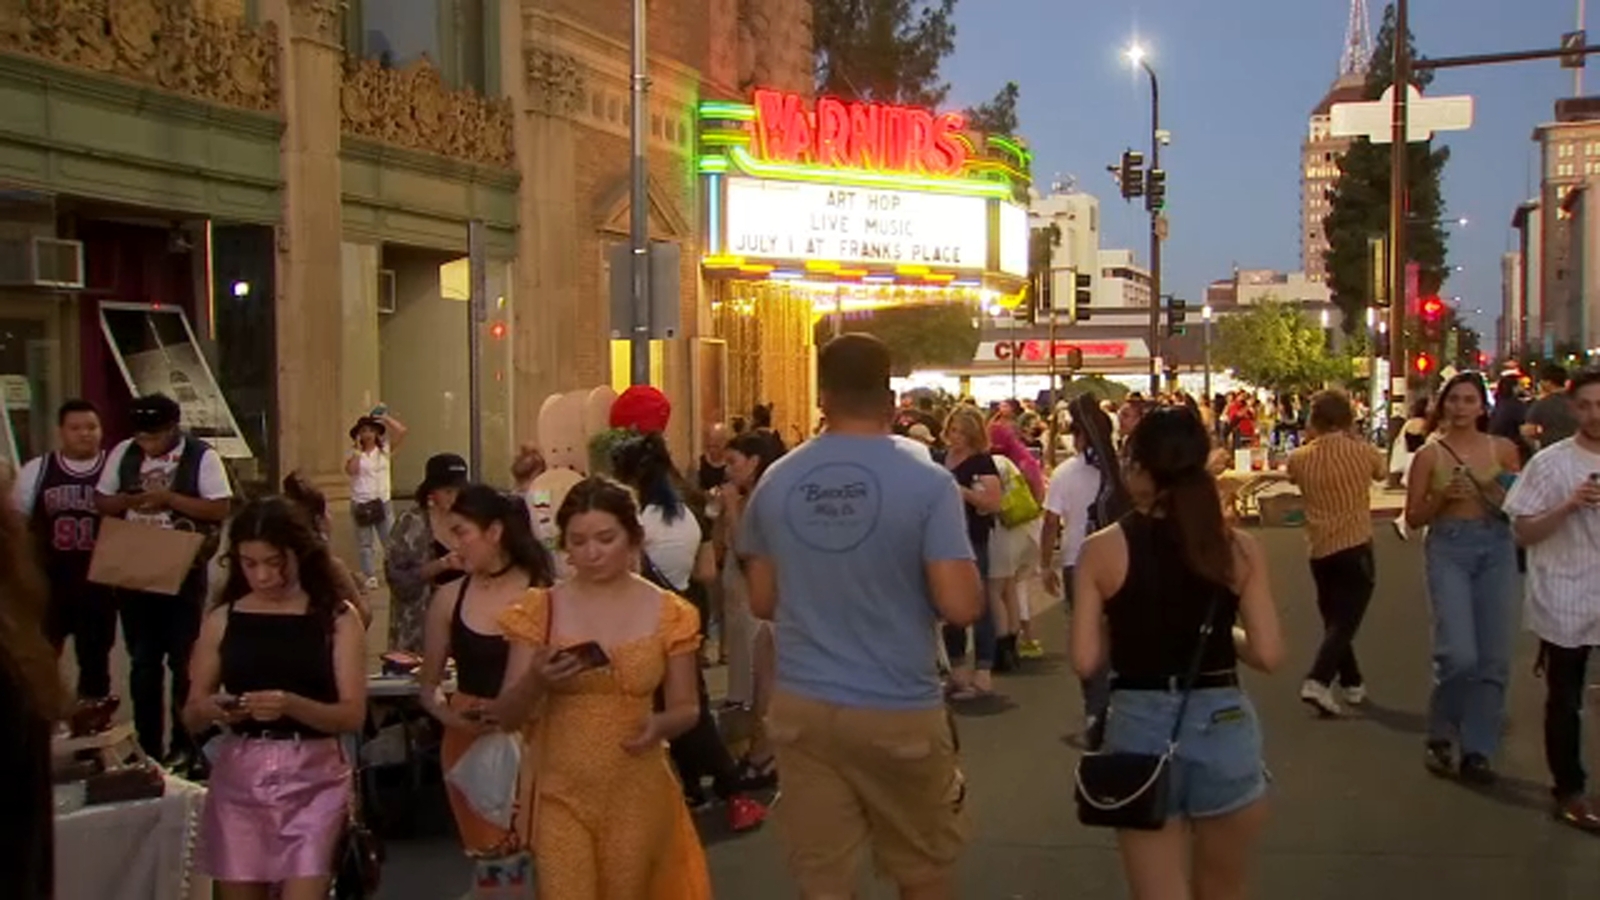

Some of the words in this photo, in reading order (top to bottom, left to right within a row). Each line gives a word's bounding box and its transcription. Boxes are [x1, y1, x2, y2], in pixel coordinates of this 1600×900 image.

[826, 190, 856, 207] ART
[867, 194, 901, 211] HOP
[810, 213, 849, 232] LIVE
[864, 219, 914, 237] MUSIC
[736, 234, 777, 254] JULY
[805, 237, 824, 255] AT
[840, 240, 902, 260] FRANKS
[912, 245, 961, 263] PLACE
[994, 340, 1040, 360] CVS
[44, 484, 99, 516] BULL
[53, 516, 94, 550] 91
